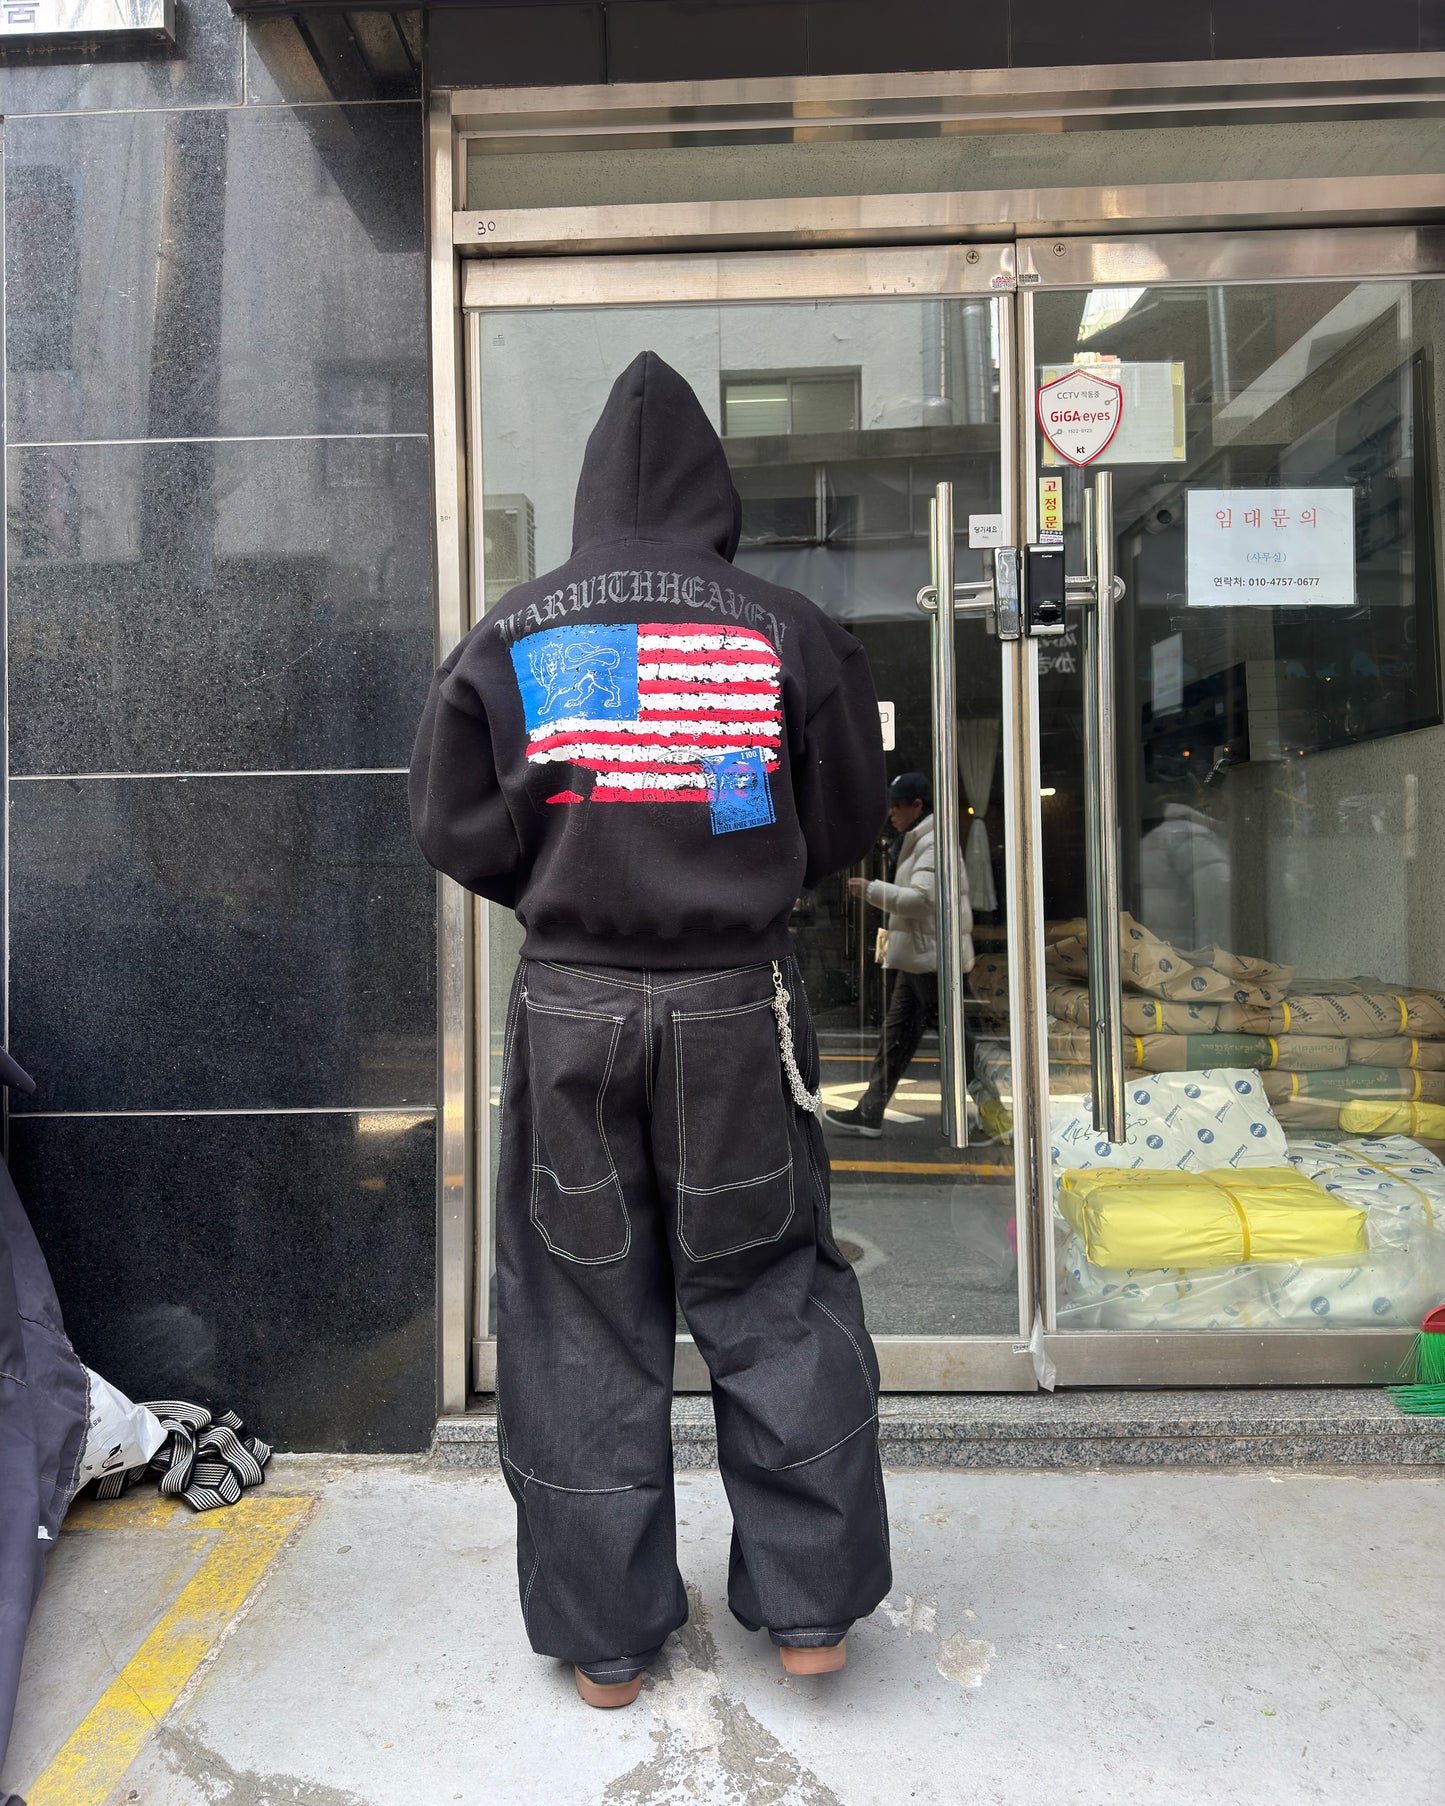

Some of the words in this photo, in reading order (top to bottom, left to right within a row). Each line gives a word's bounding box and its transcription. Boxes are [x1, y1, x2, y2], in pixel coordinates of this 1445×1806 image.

[477, 221, 496, 236] 30
[1056, 391, 1080, 400] CCTV
[1050, 410, 1081, 423] GiGA
[1082, 411, 1111, 424] eyes
[1076, 446, 1086, 454] kt
[1044, 480, 1058, 529] 고정문
[974, 525, 998, 534] 당기세요
[1246, 552, 1287, 563] (사무실)
[1213, 576, 1246, 587] 연락처:
[1248, 576, 1320, 587] 010-4757-0677
